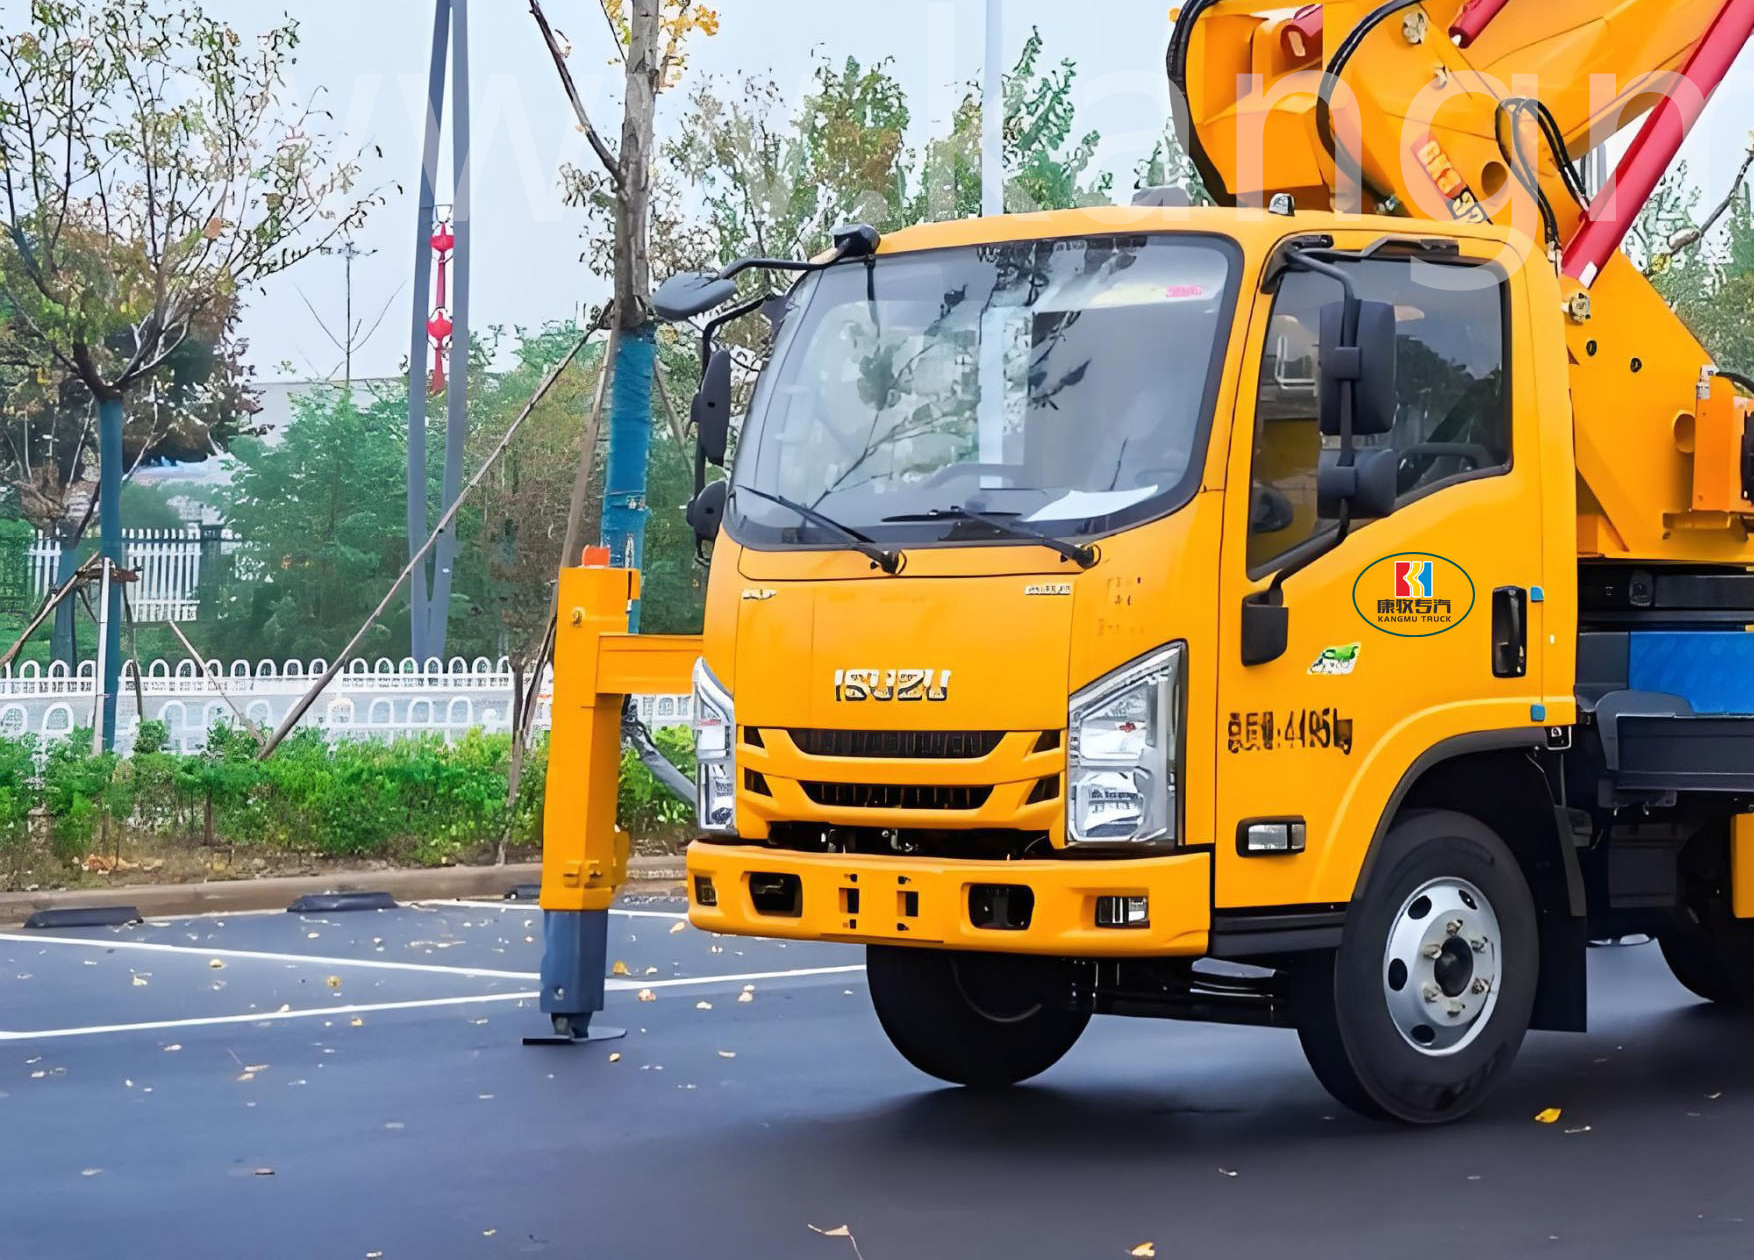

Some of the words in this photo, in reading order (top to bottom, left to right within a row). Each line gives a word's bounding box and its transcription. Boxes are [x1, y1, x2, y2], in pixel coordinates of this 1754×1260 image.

[1377, 599, 1451, 614] 康牧专汽
[1377, 615, 1418, 623] KANGMU
[1421, 615, 1452, 623] TRUCK
[834, 668, 952, 702] ISUZU
